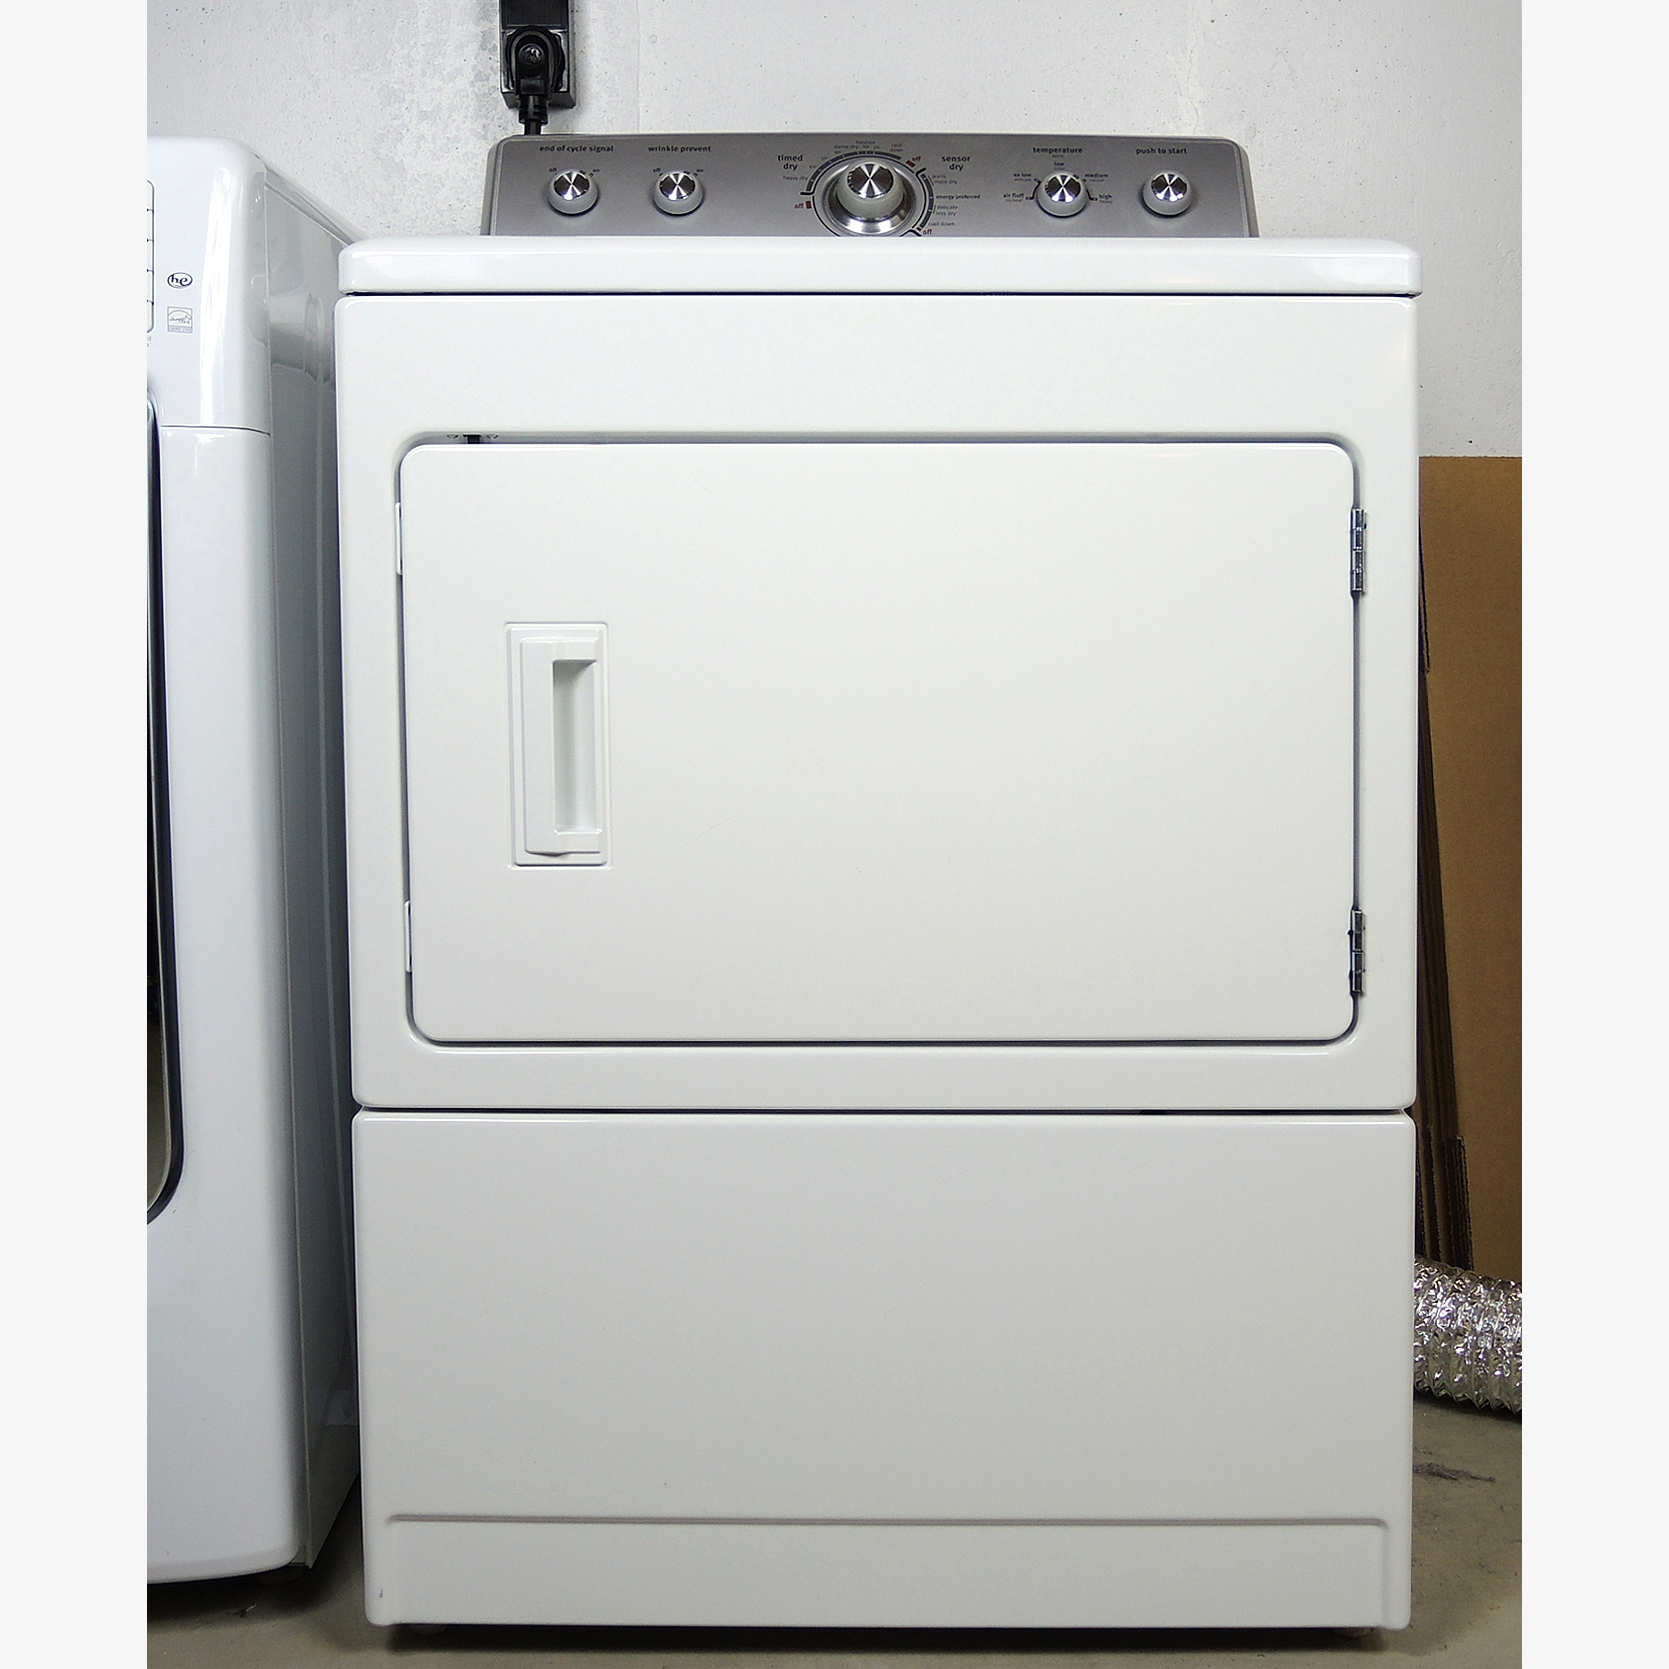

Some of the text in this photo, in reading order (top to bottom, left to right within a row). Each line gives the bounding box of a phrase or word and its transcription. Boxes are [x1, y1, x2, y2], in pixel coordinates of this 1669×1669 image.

[566, 145, 587, 153] cycle
[589, 145, 614, 153] signal
[680, 145, 711, 153] prevent
[1135, 147, 1156, 155] push
[783, 162, 798, 171] dry
[949, 163, 964, 172] dry
